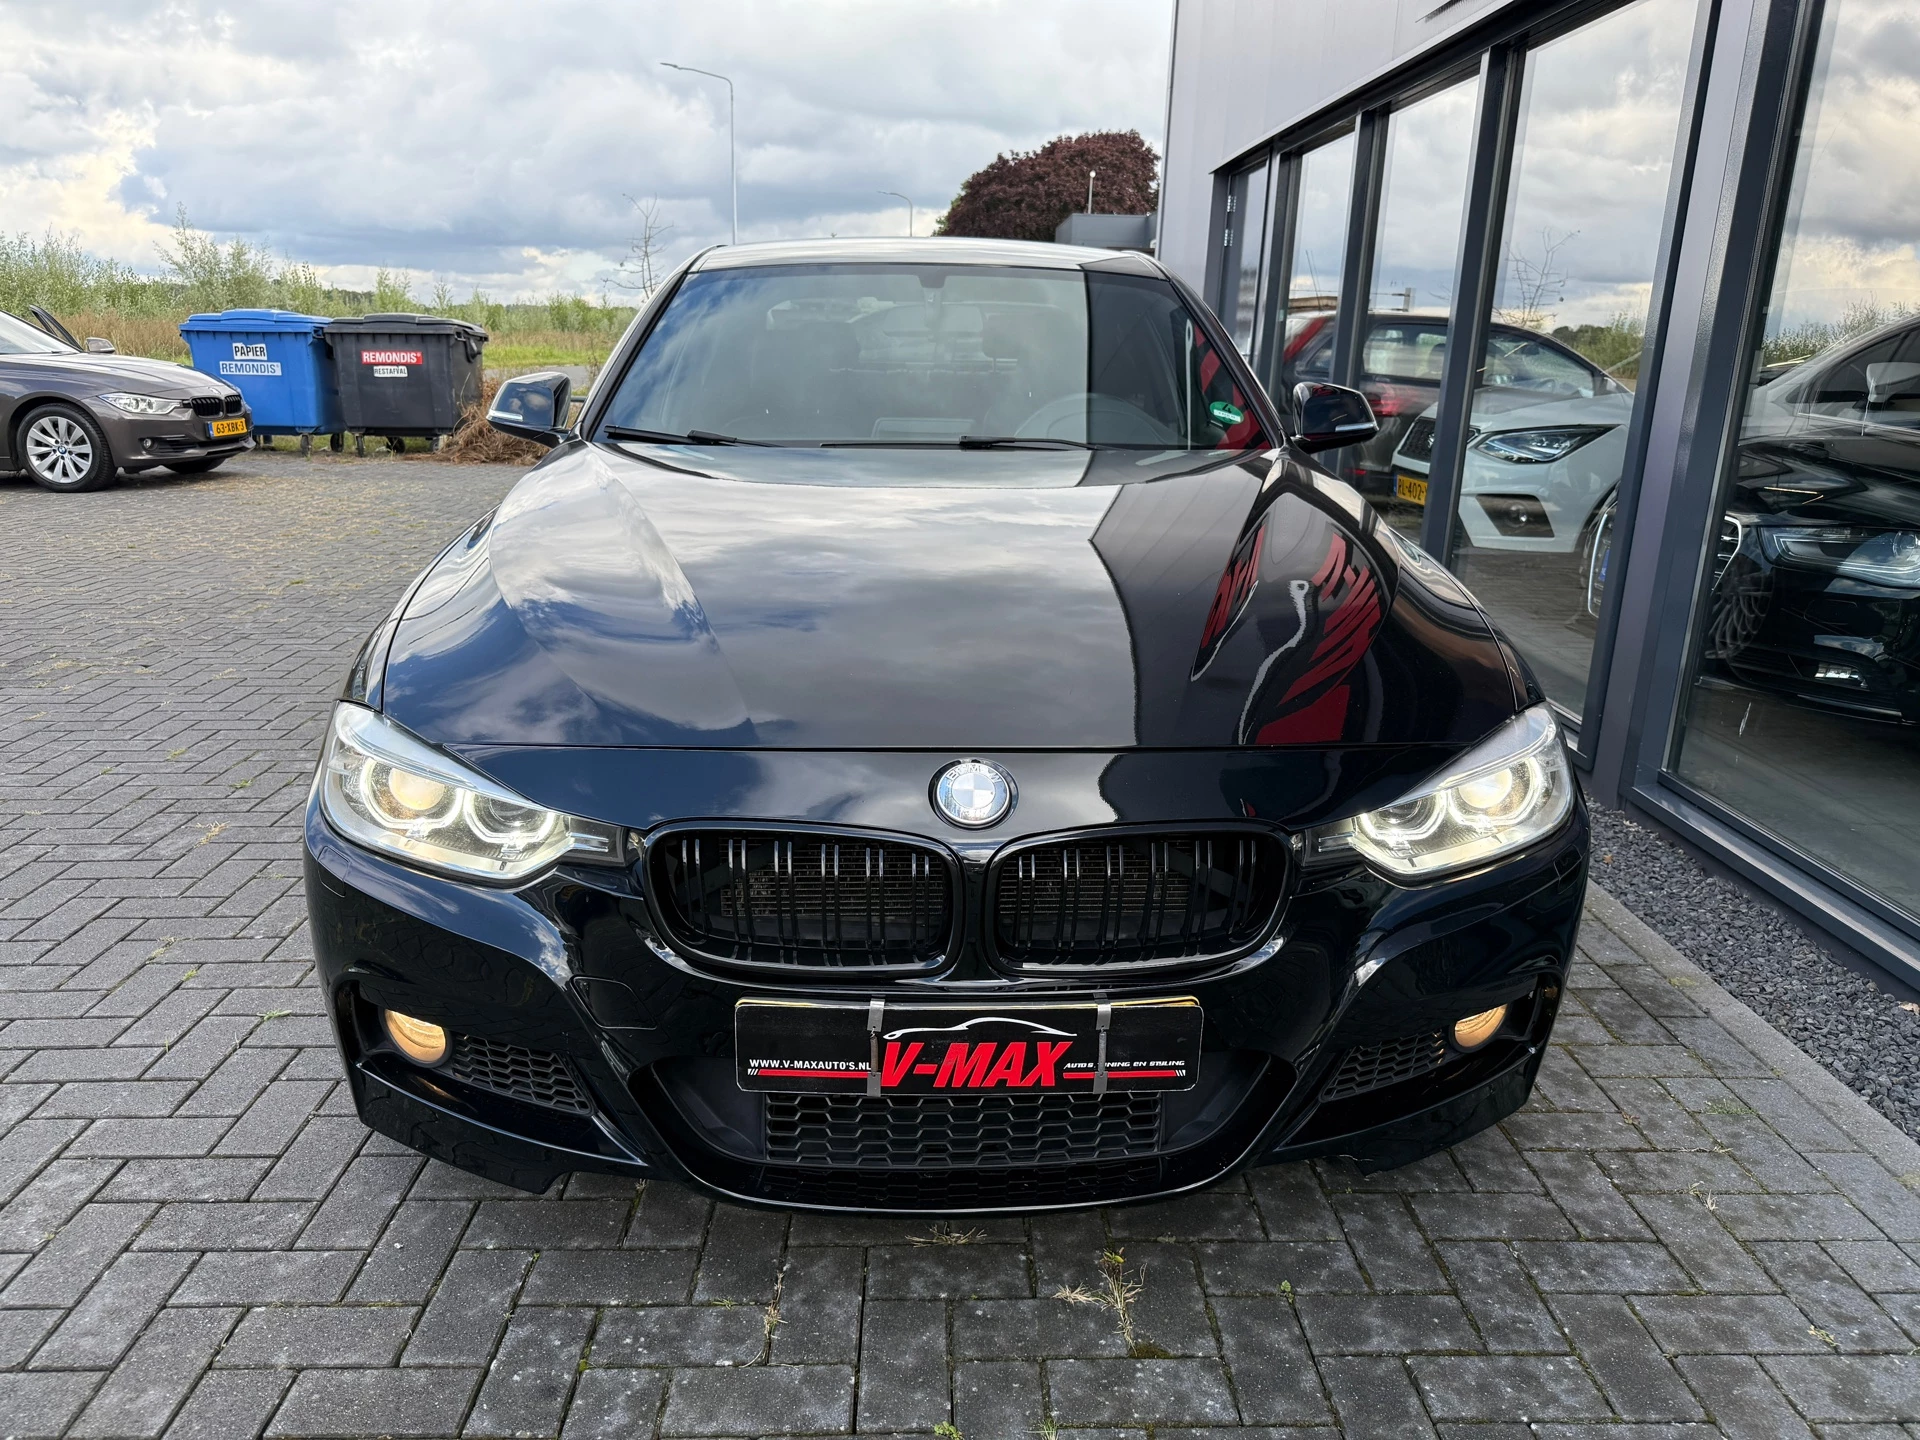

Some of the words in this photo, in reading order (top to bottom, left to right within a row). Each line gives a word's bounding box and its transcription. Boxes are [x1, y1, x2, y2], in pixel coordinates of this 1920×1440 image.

[234, 346, 266, 357] PAPIER
[363, 352, 417, 363] REMONDIS
[221, 363, 276, 374] REMONDIS
[216, 421, 245, 434] 63-XBK-3
[1398, 478, 1427, 501] RL-402-
[749, 1059, 872, 1070] WWW.V-MAXAUTO'S.NL
[880, 1040, 1074, 1088] V-MAX
